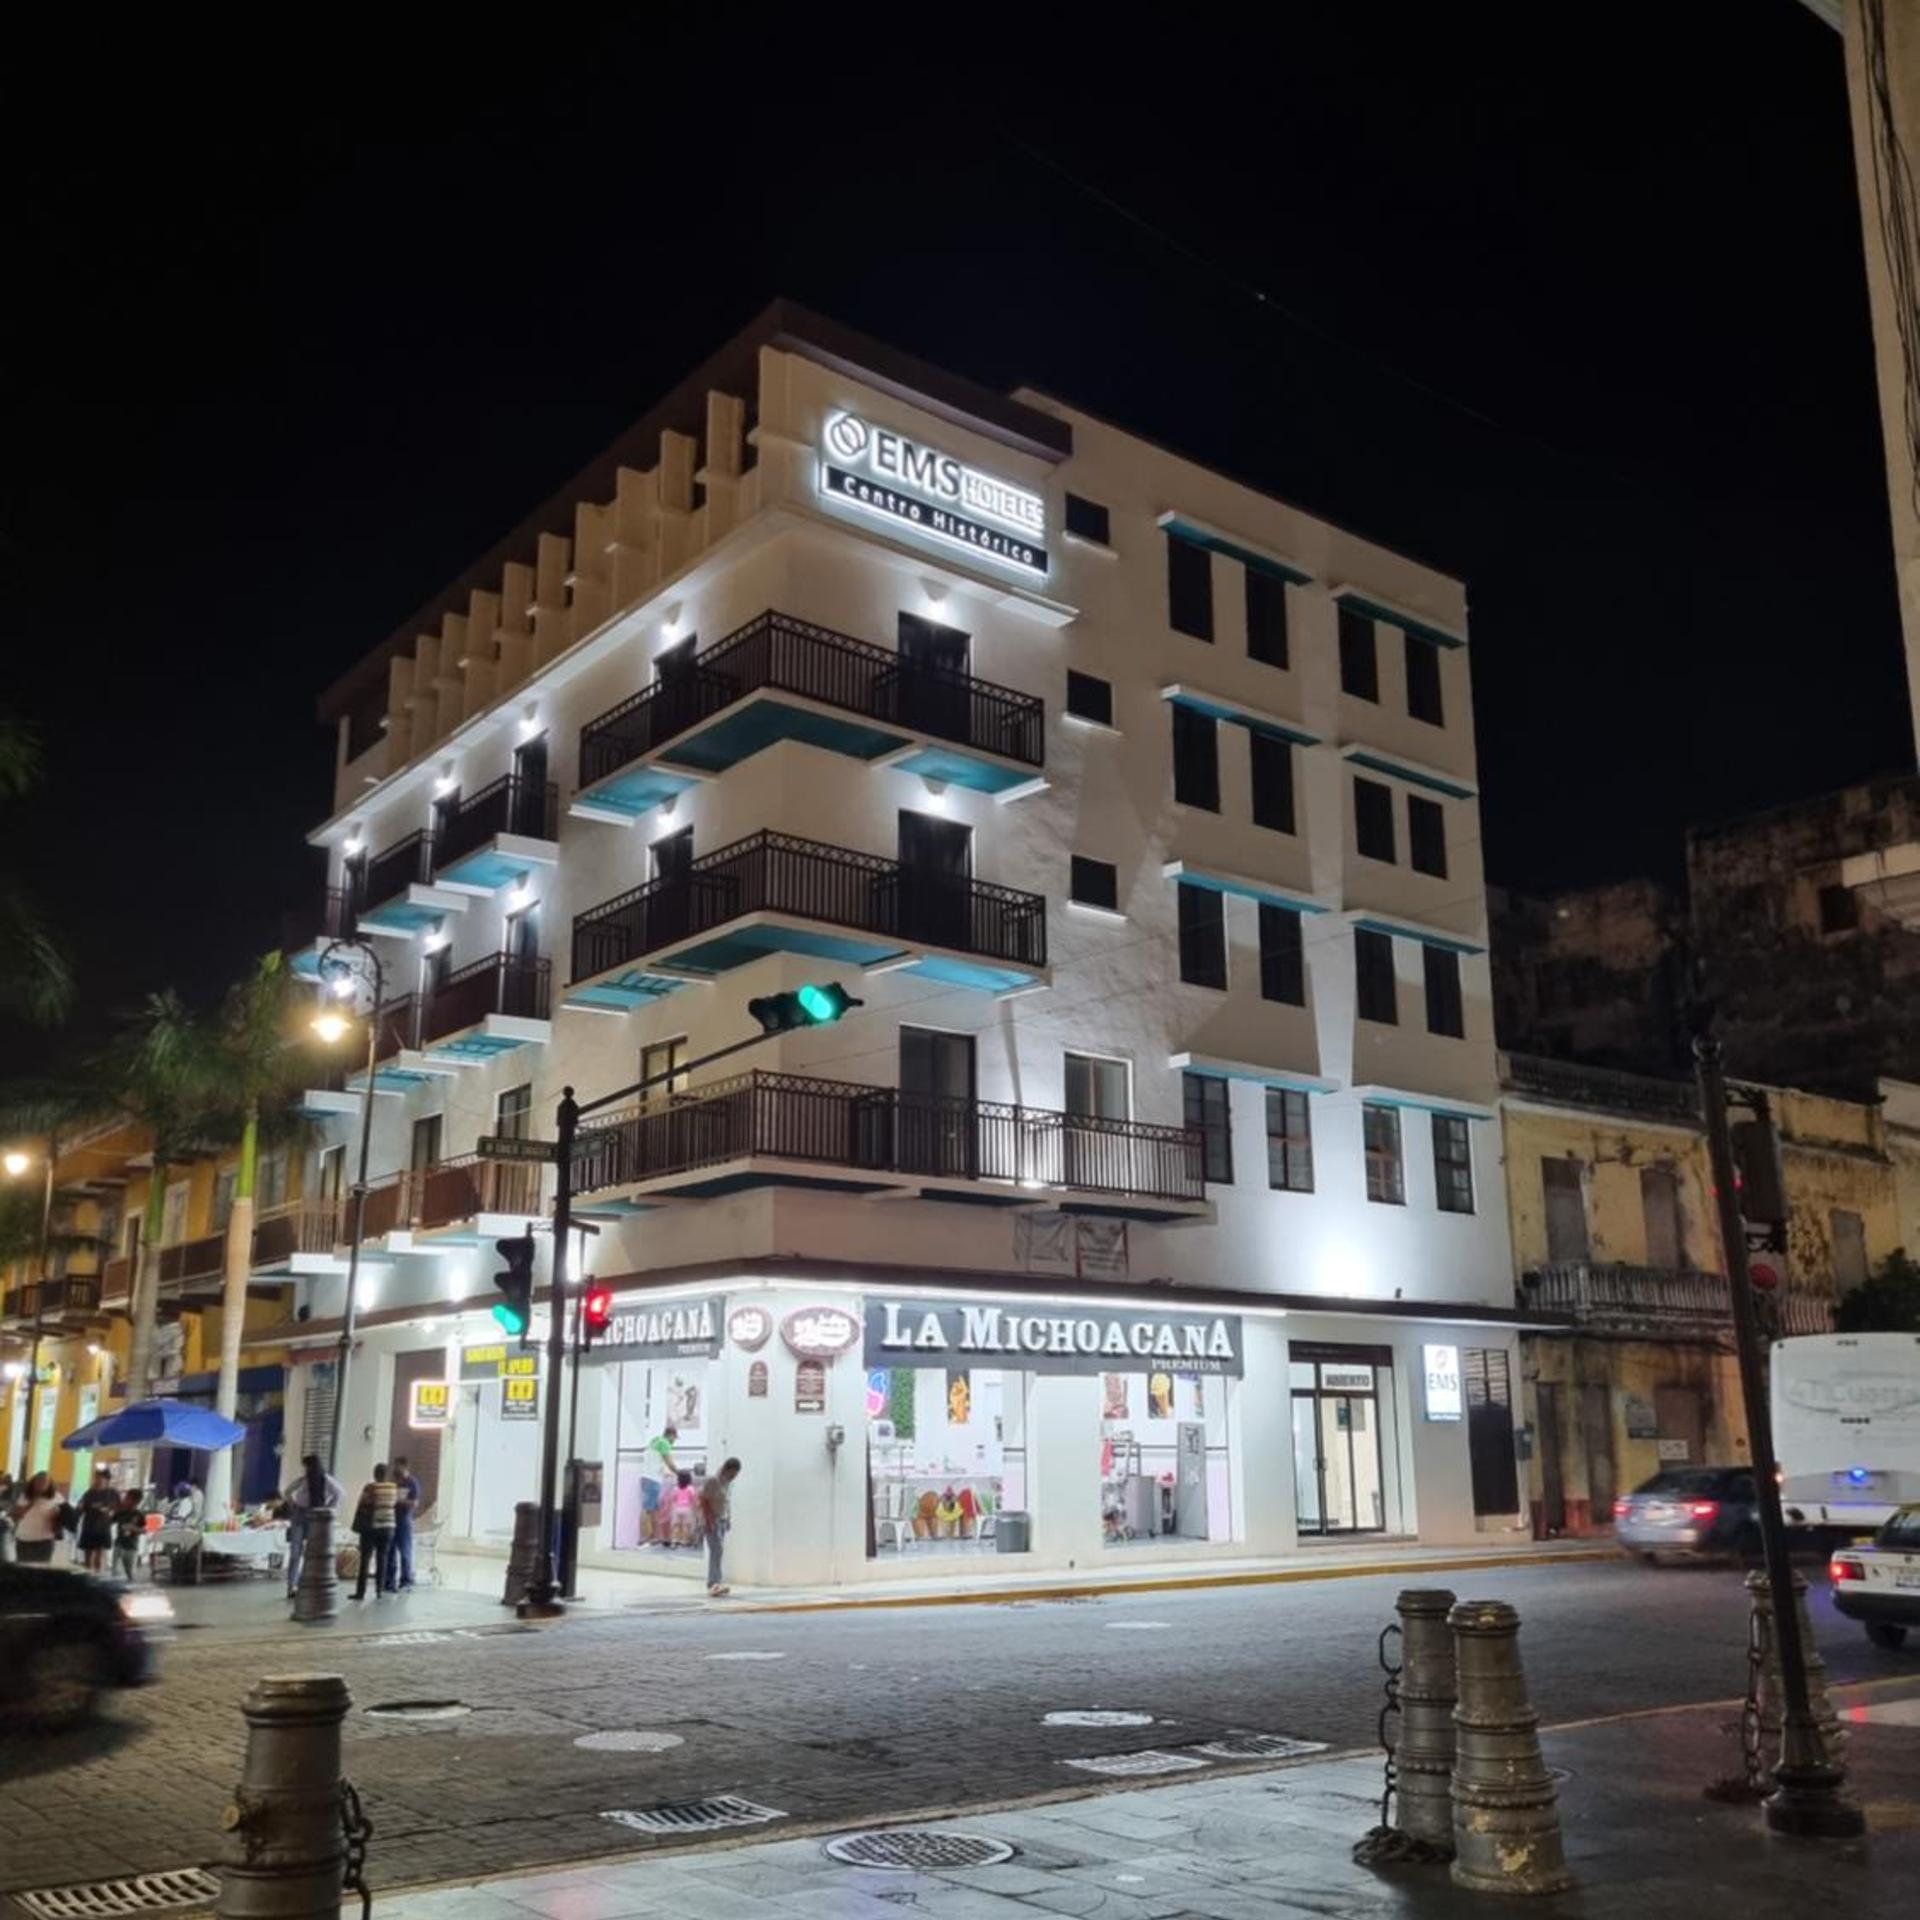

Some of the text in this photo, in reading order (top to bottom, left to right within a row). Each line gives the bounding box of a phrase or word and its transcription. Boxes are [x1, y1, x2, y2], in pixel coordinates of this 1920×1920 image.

[876, 430, 1044, 525] EMS HOTELES
[843, 475, 1034, 564] Centro Histórico
[881, 1303, 948, 1348] LA
[958, 1306, 1234, 1358] MICHOACANA
[1151, 1358, 1222, 1372] PREMIUM
[1428, 1372, 1458, 1393] EMS
